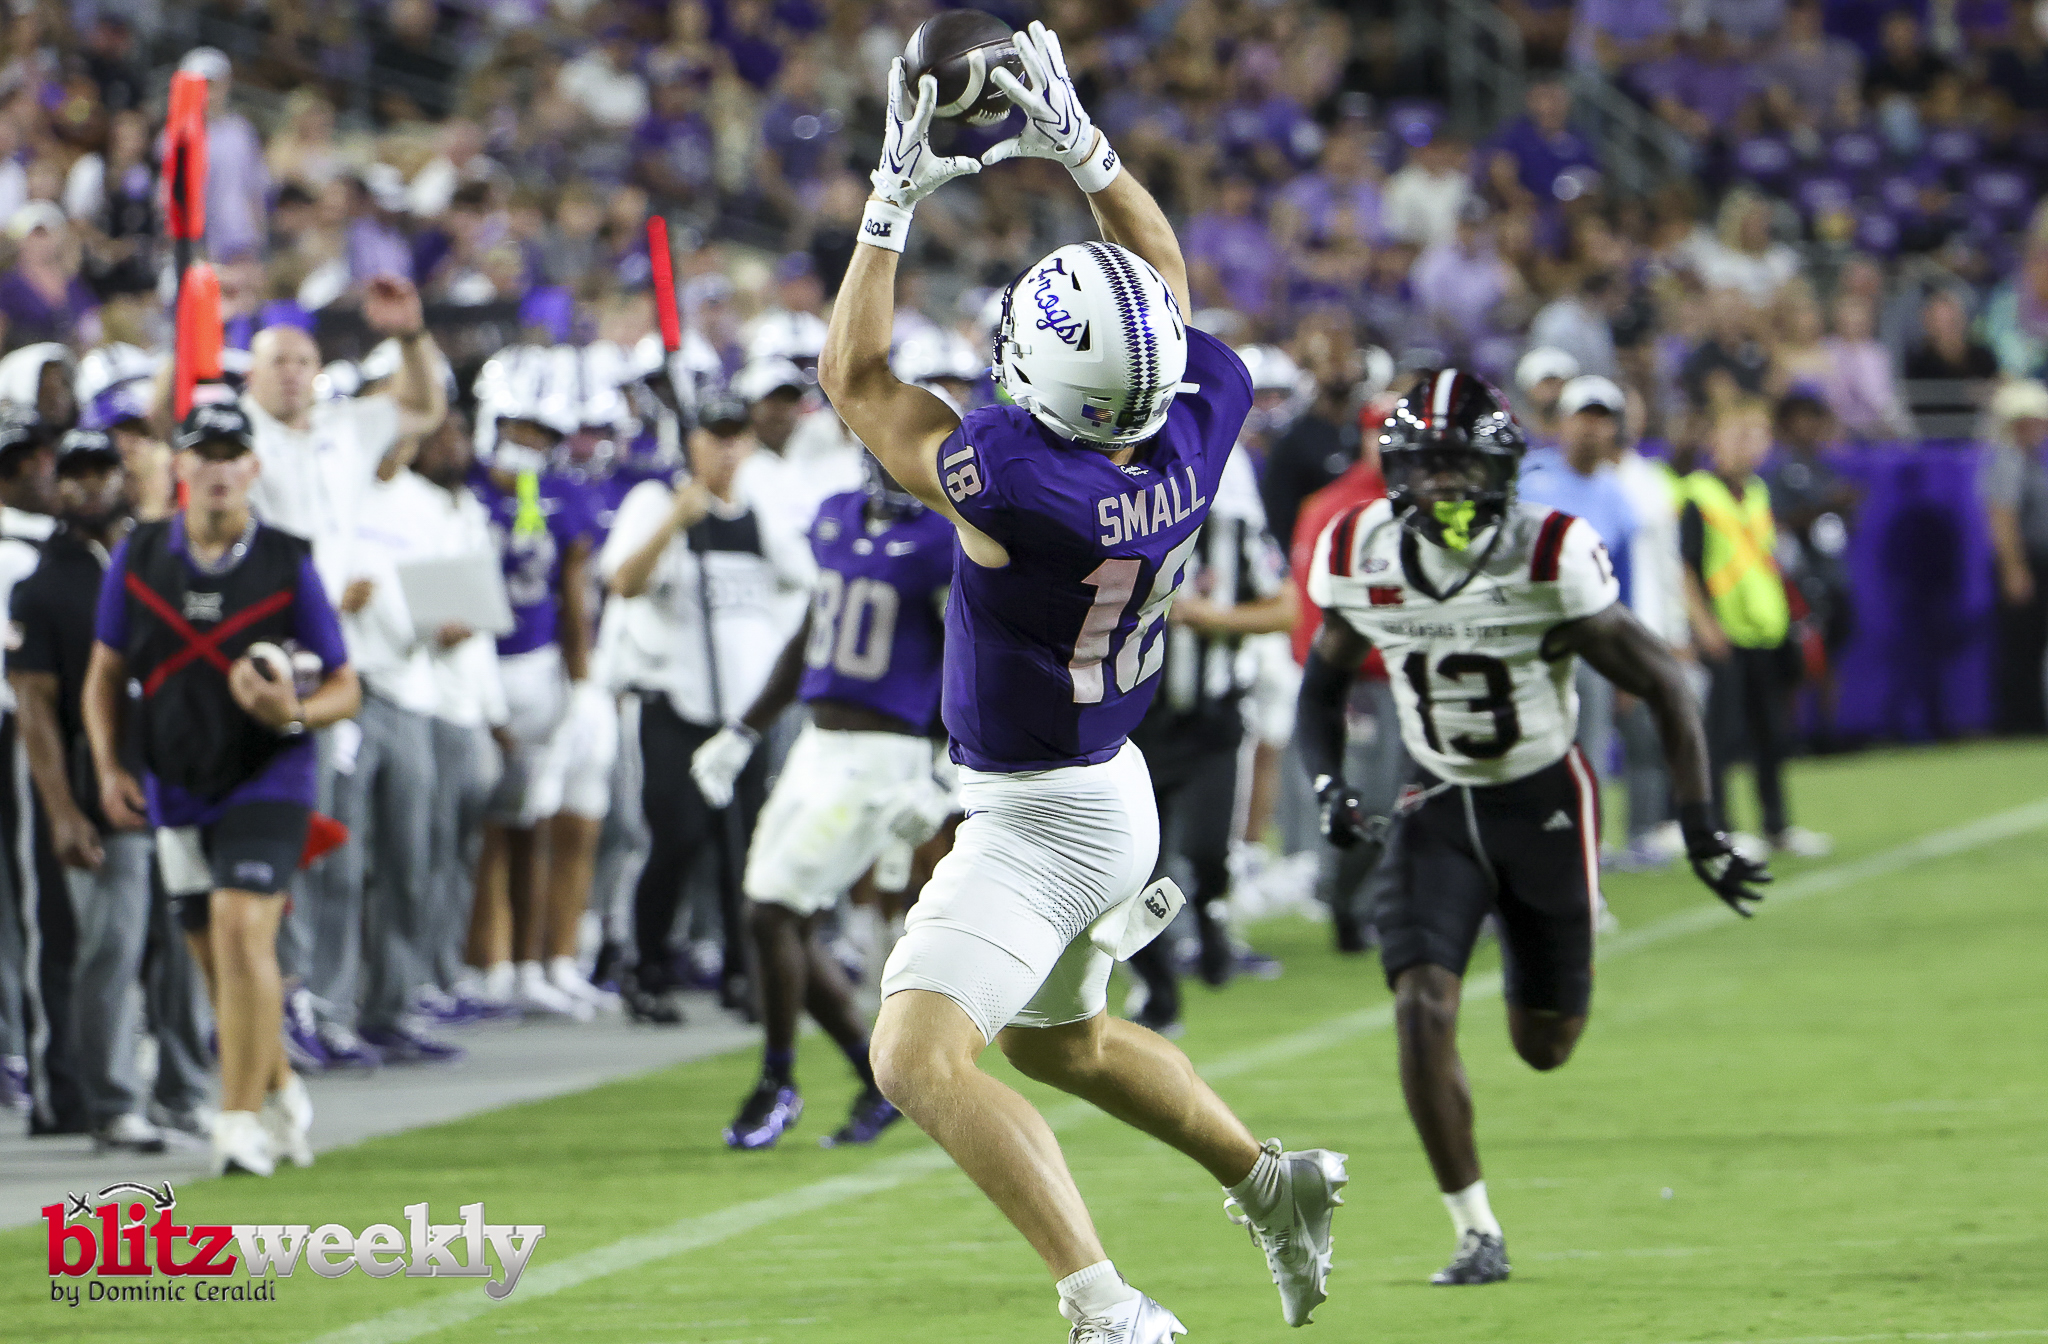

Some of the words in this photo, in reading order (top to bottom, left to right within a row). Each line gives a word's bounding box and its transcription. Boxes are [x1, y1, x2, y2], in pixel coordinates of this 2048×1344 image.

[1102, 144, 1116, 171] CU
[864, 218, 891, 237] TCU
[1028, 257, 1082, 345] Frogs
[942, 444, 983, 503] 18
[1097, 465, 1206, 547] SMALL
[1068, 524, 1203, 704] 18
[1402, 650, 1521, 760] 13
